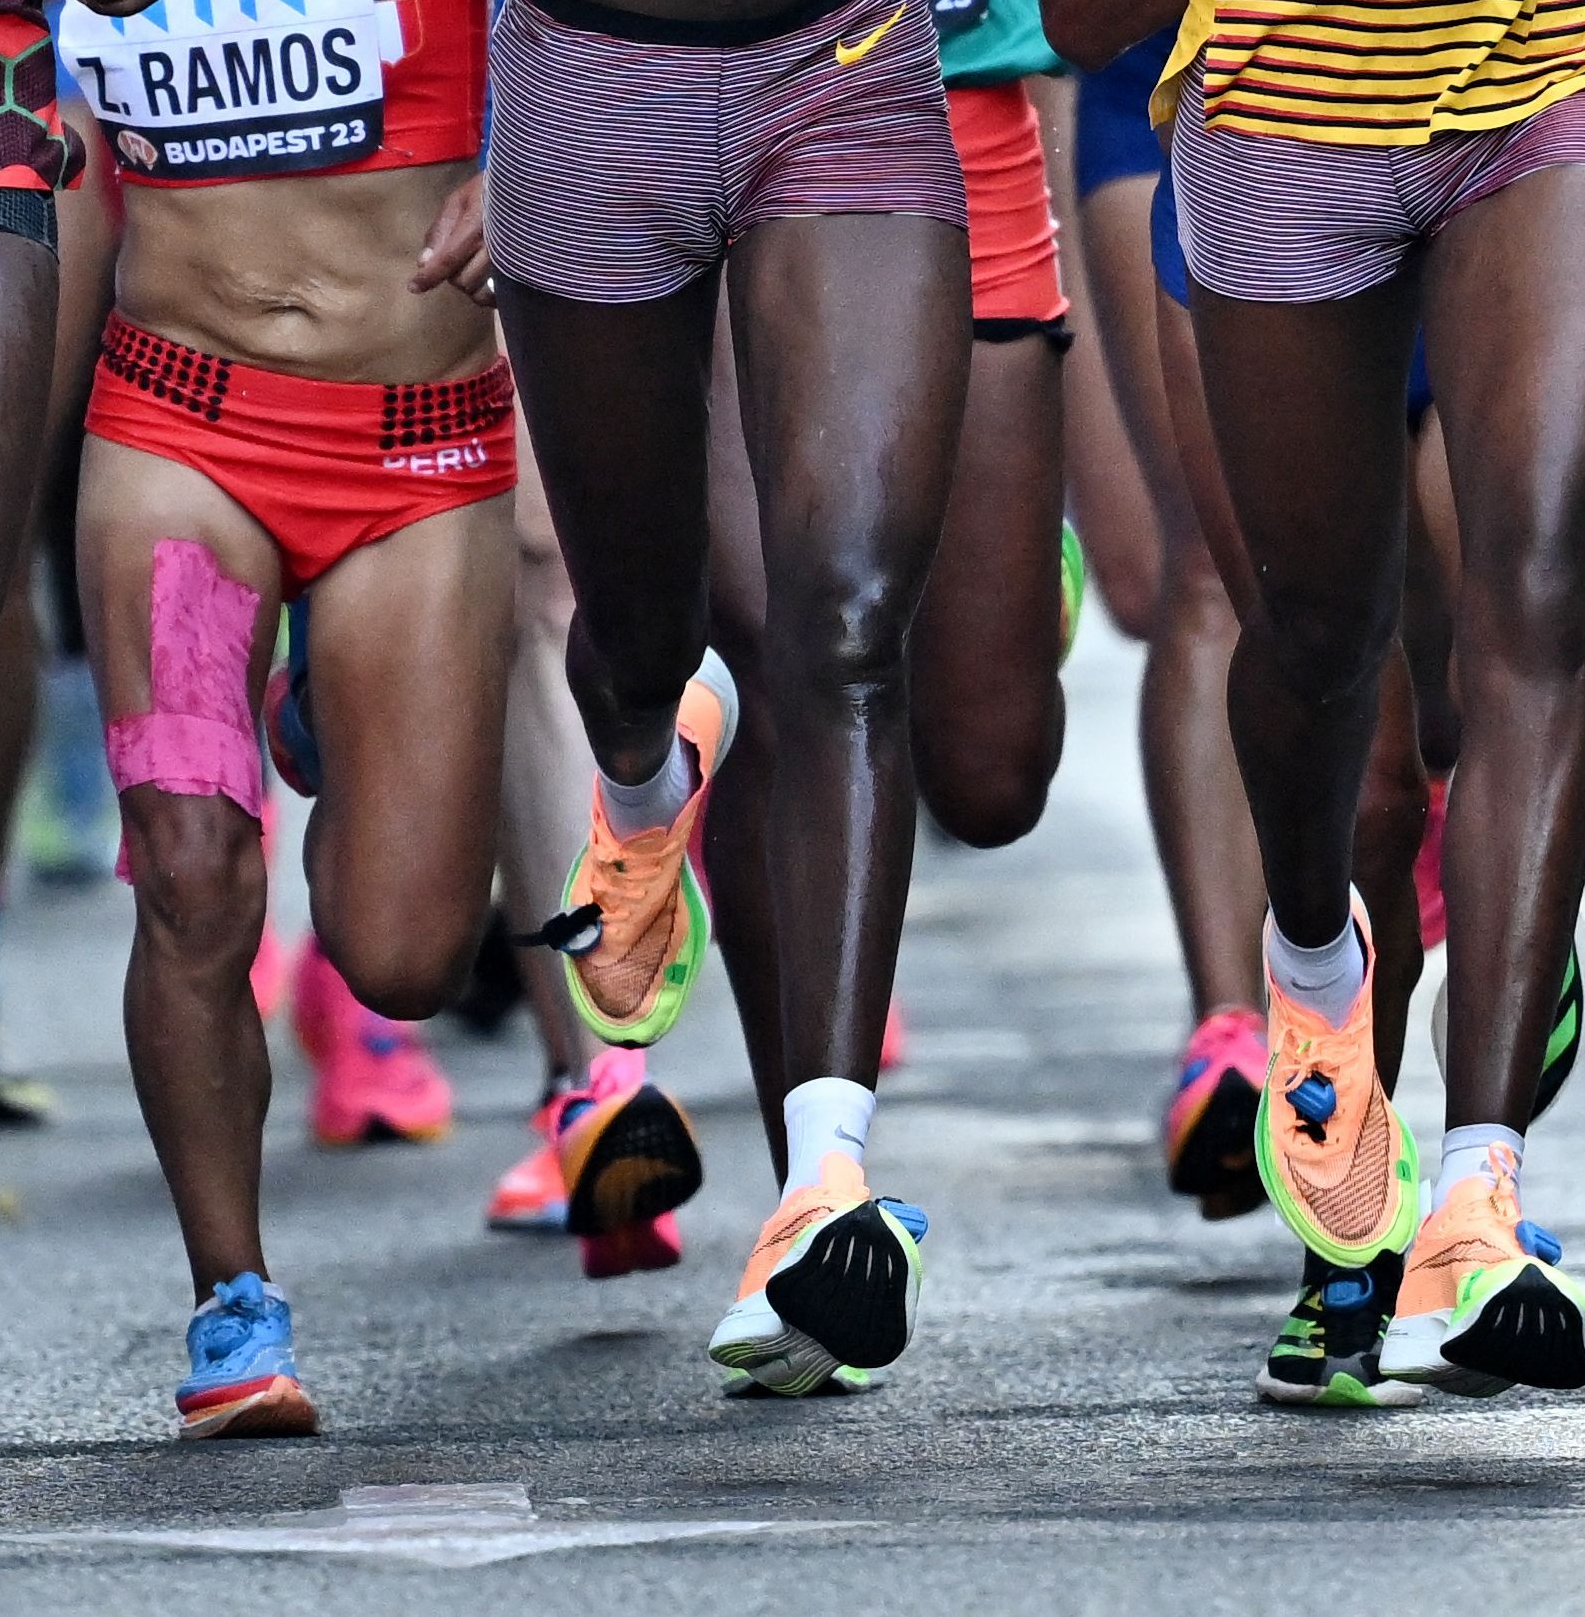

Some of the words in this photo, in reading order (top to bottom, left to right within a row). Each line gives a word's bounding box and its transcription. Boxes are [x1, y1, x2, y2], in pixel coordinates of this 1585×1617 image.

[77, 56, 132, 117] Z.
[139, 27, 363, 118] RAMOS
[164, 126, 326, 165] BUDAPEST
[329, 119, 367, 150] 23
